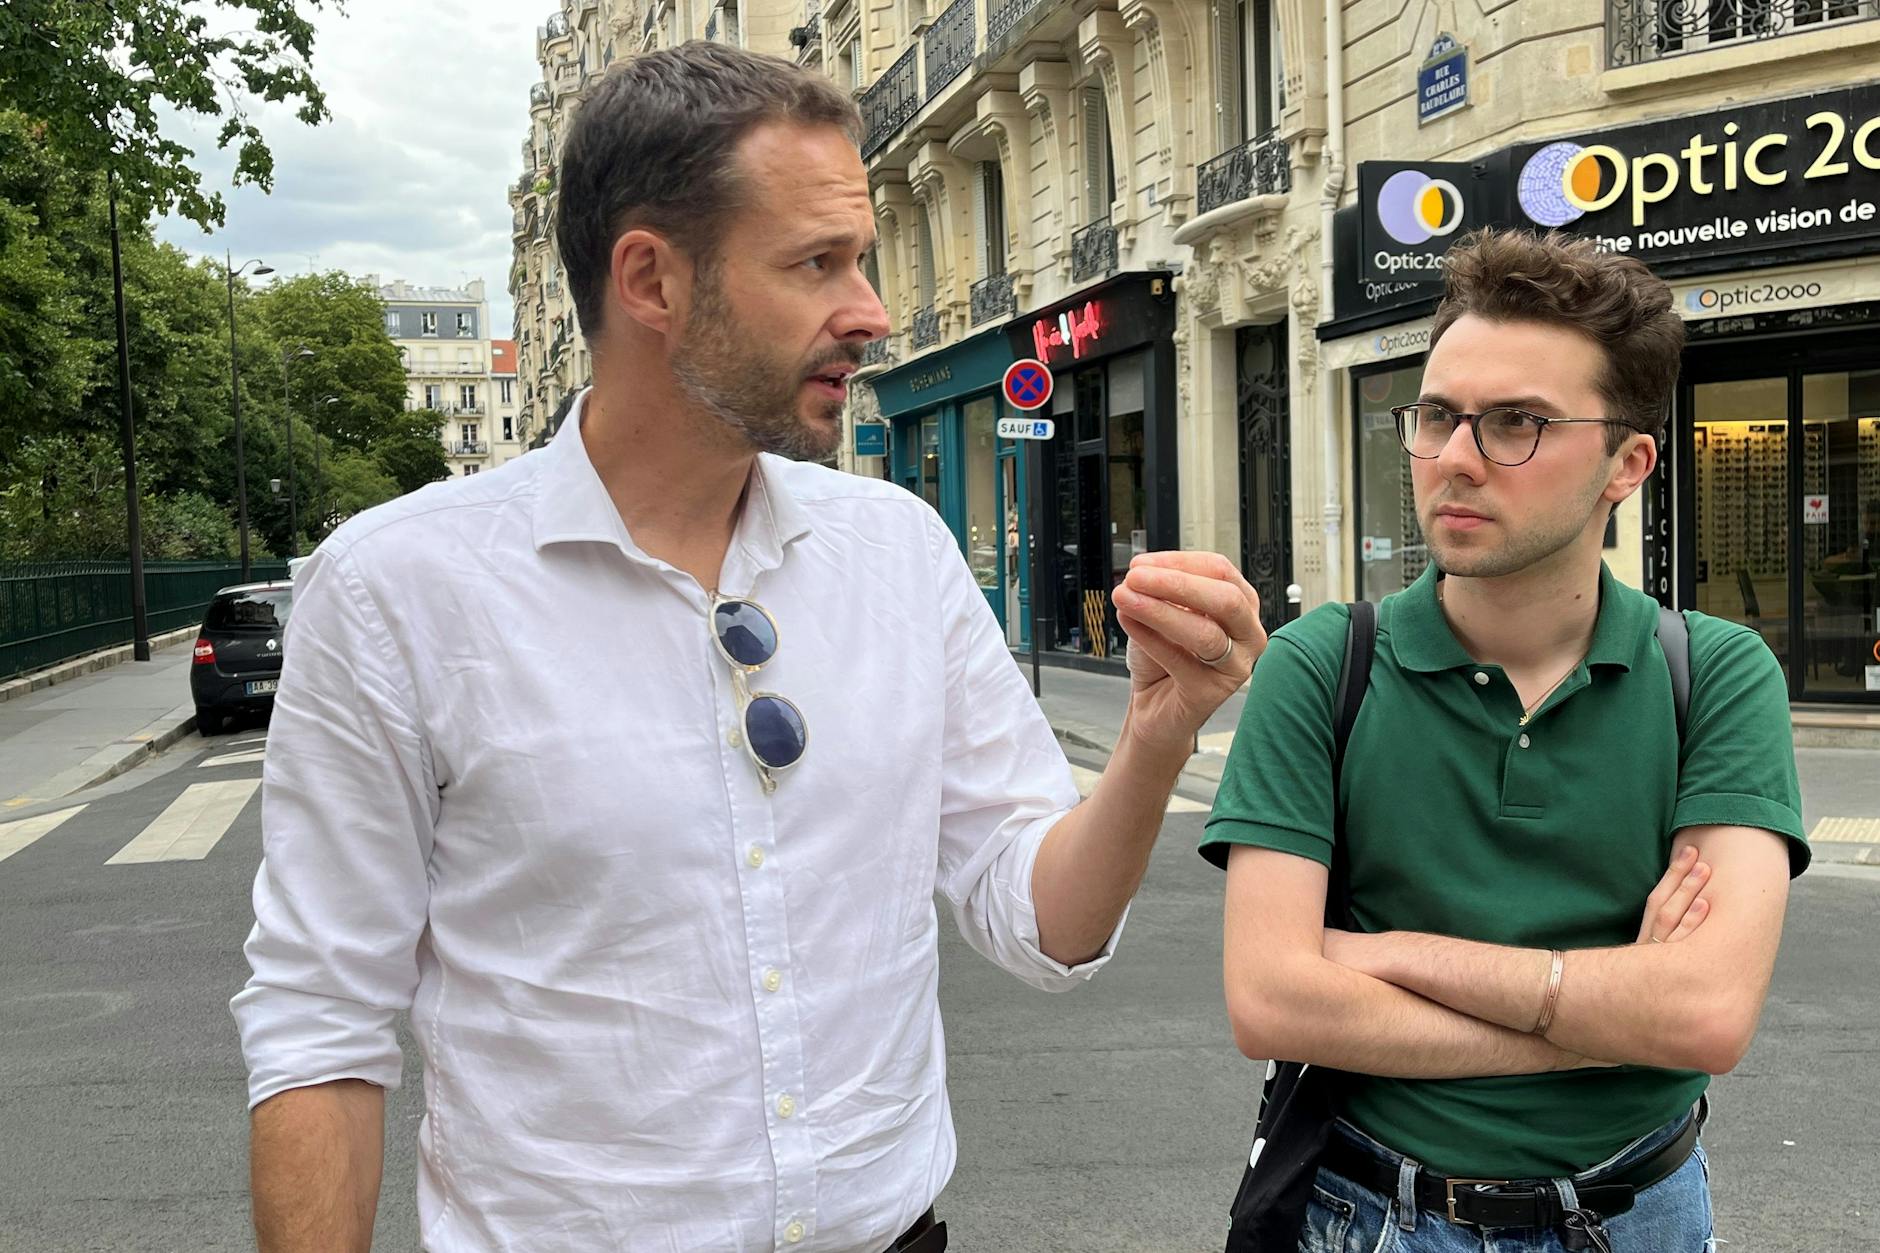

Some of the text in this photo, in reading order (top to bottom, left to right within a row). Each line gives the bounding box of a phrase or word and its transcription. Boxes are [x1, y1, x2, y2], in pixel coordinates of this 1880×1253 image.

[1425, 74, 1460, 97] CHARLES
[1435, 65, 1450, 80] RUE
[1421, 84, 1465, 113] BAUDELAIRE
[1562, 121, 1788, 227] Optic
[1638, 216, 1748, 250] nouvelle
[1755, 207, 1832, 234] vision
[1839, 199, 1876, 224] de
[1001, 423, 1032, 433] SAUF
